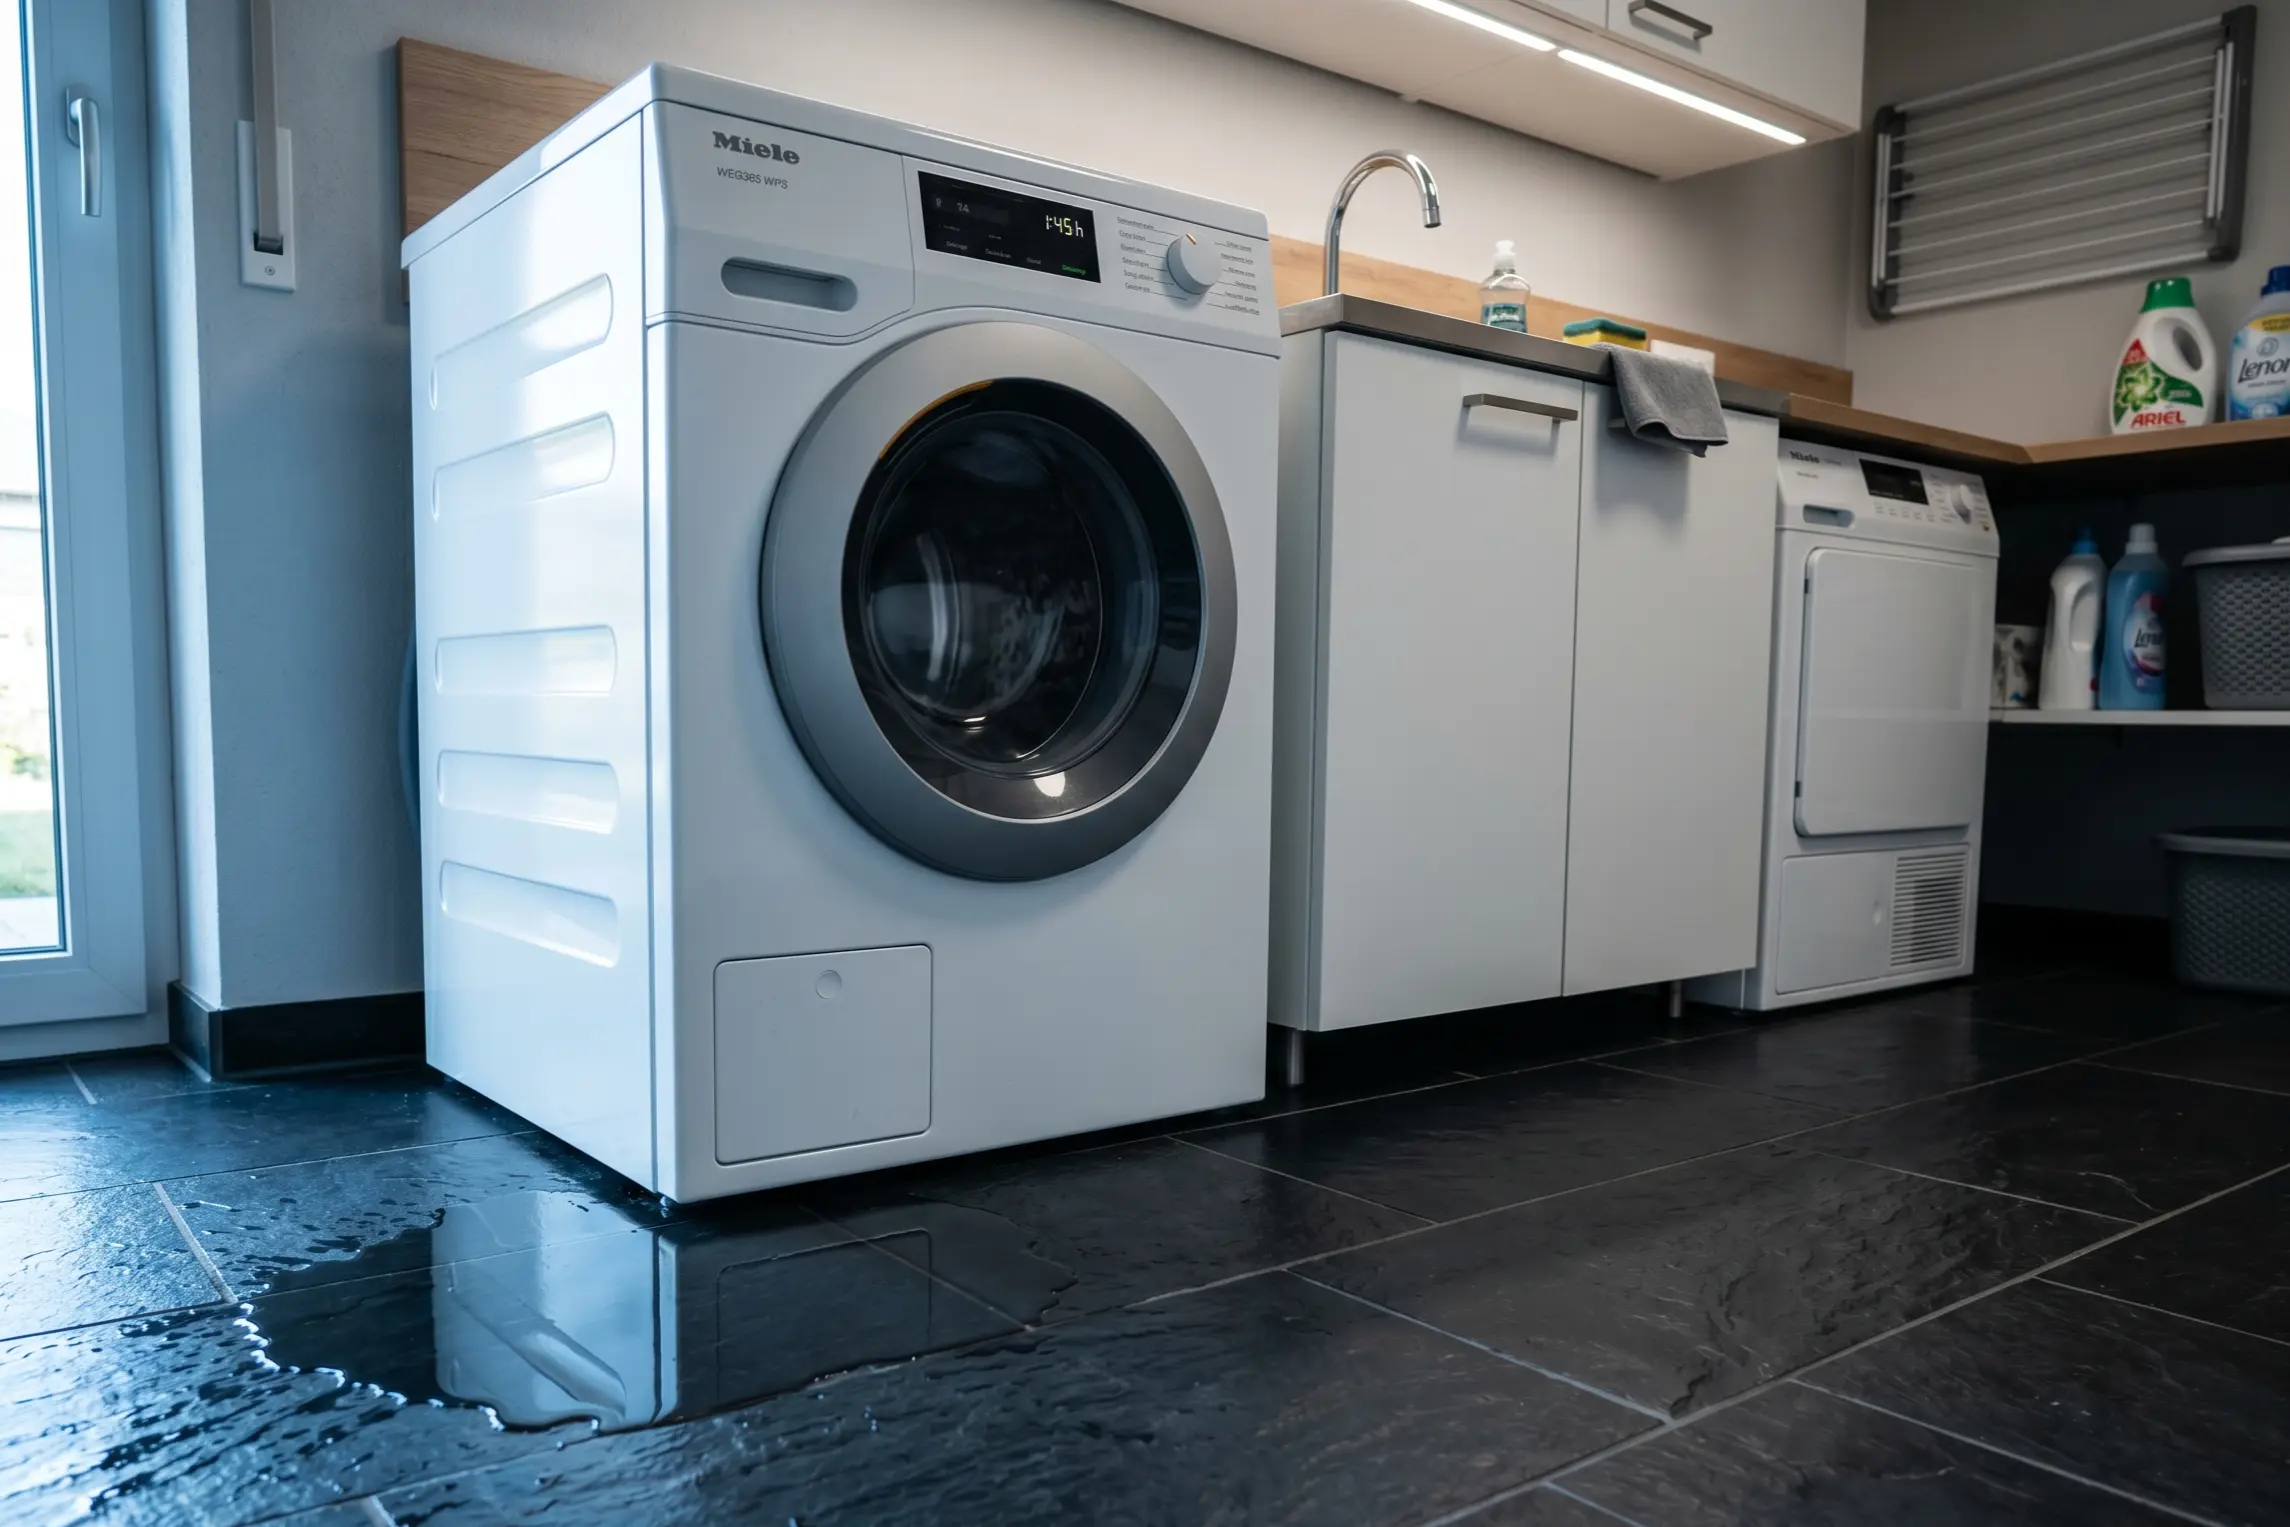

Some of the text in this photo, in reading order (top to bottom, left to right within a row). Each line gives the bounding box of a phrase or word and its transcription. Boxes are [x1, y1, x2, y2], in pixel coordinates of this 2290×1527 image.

[712, 131, 800, 165] Miele
[763, 176, 788, 189] WPS
[2237, 357, 2290, 383] Lenor
[2130, 410, 2187, 428] ARIEL
